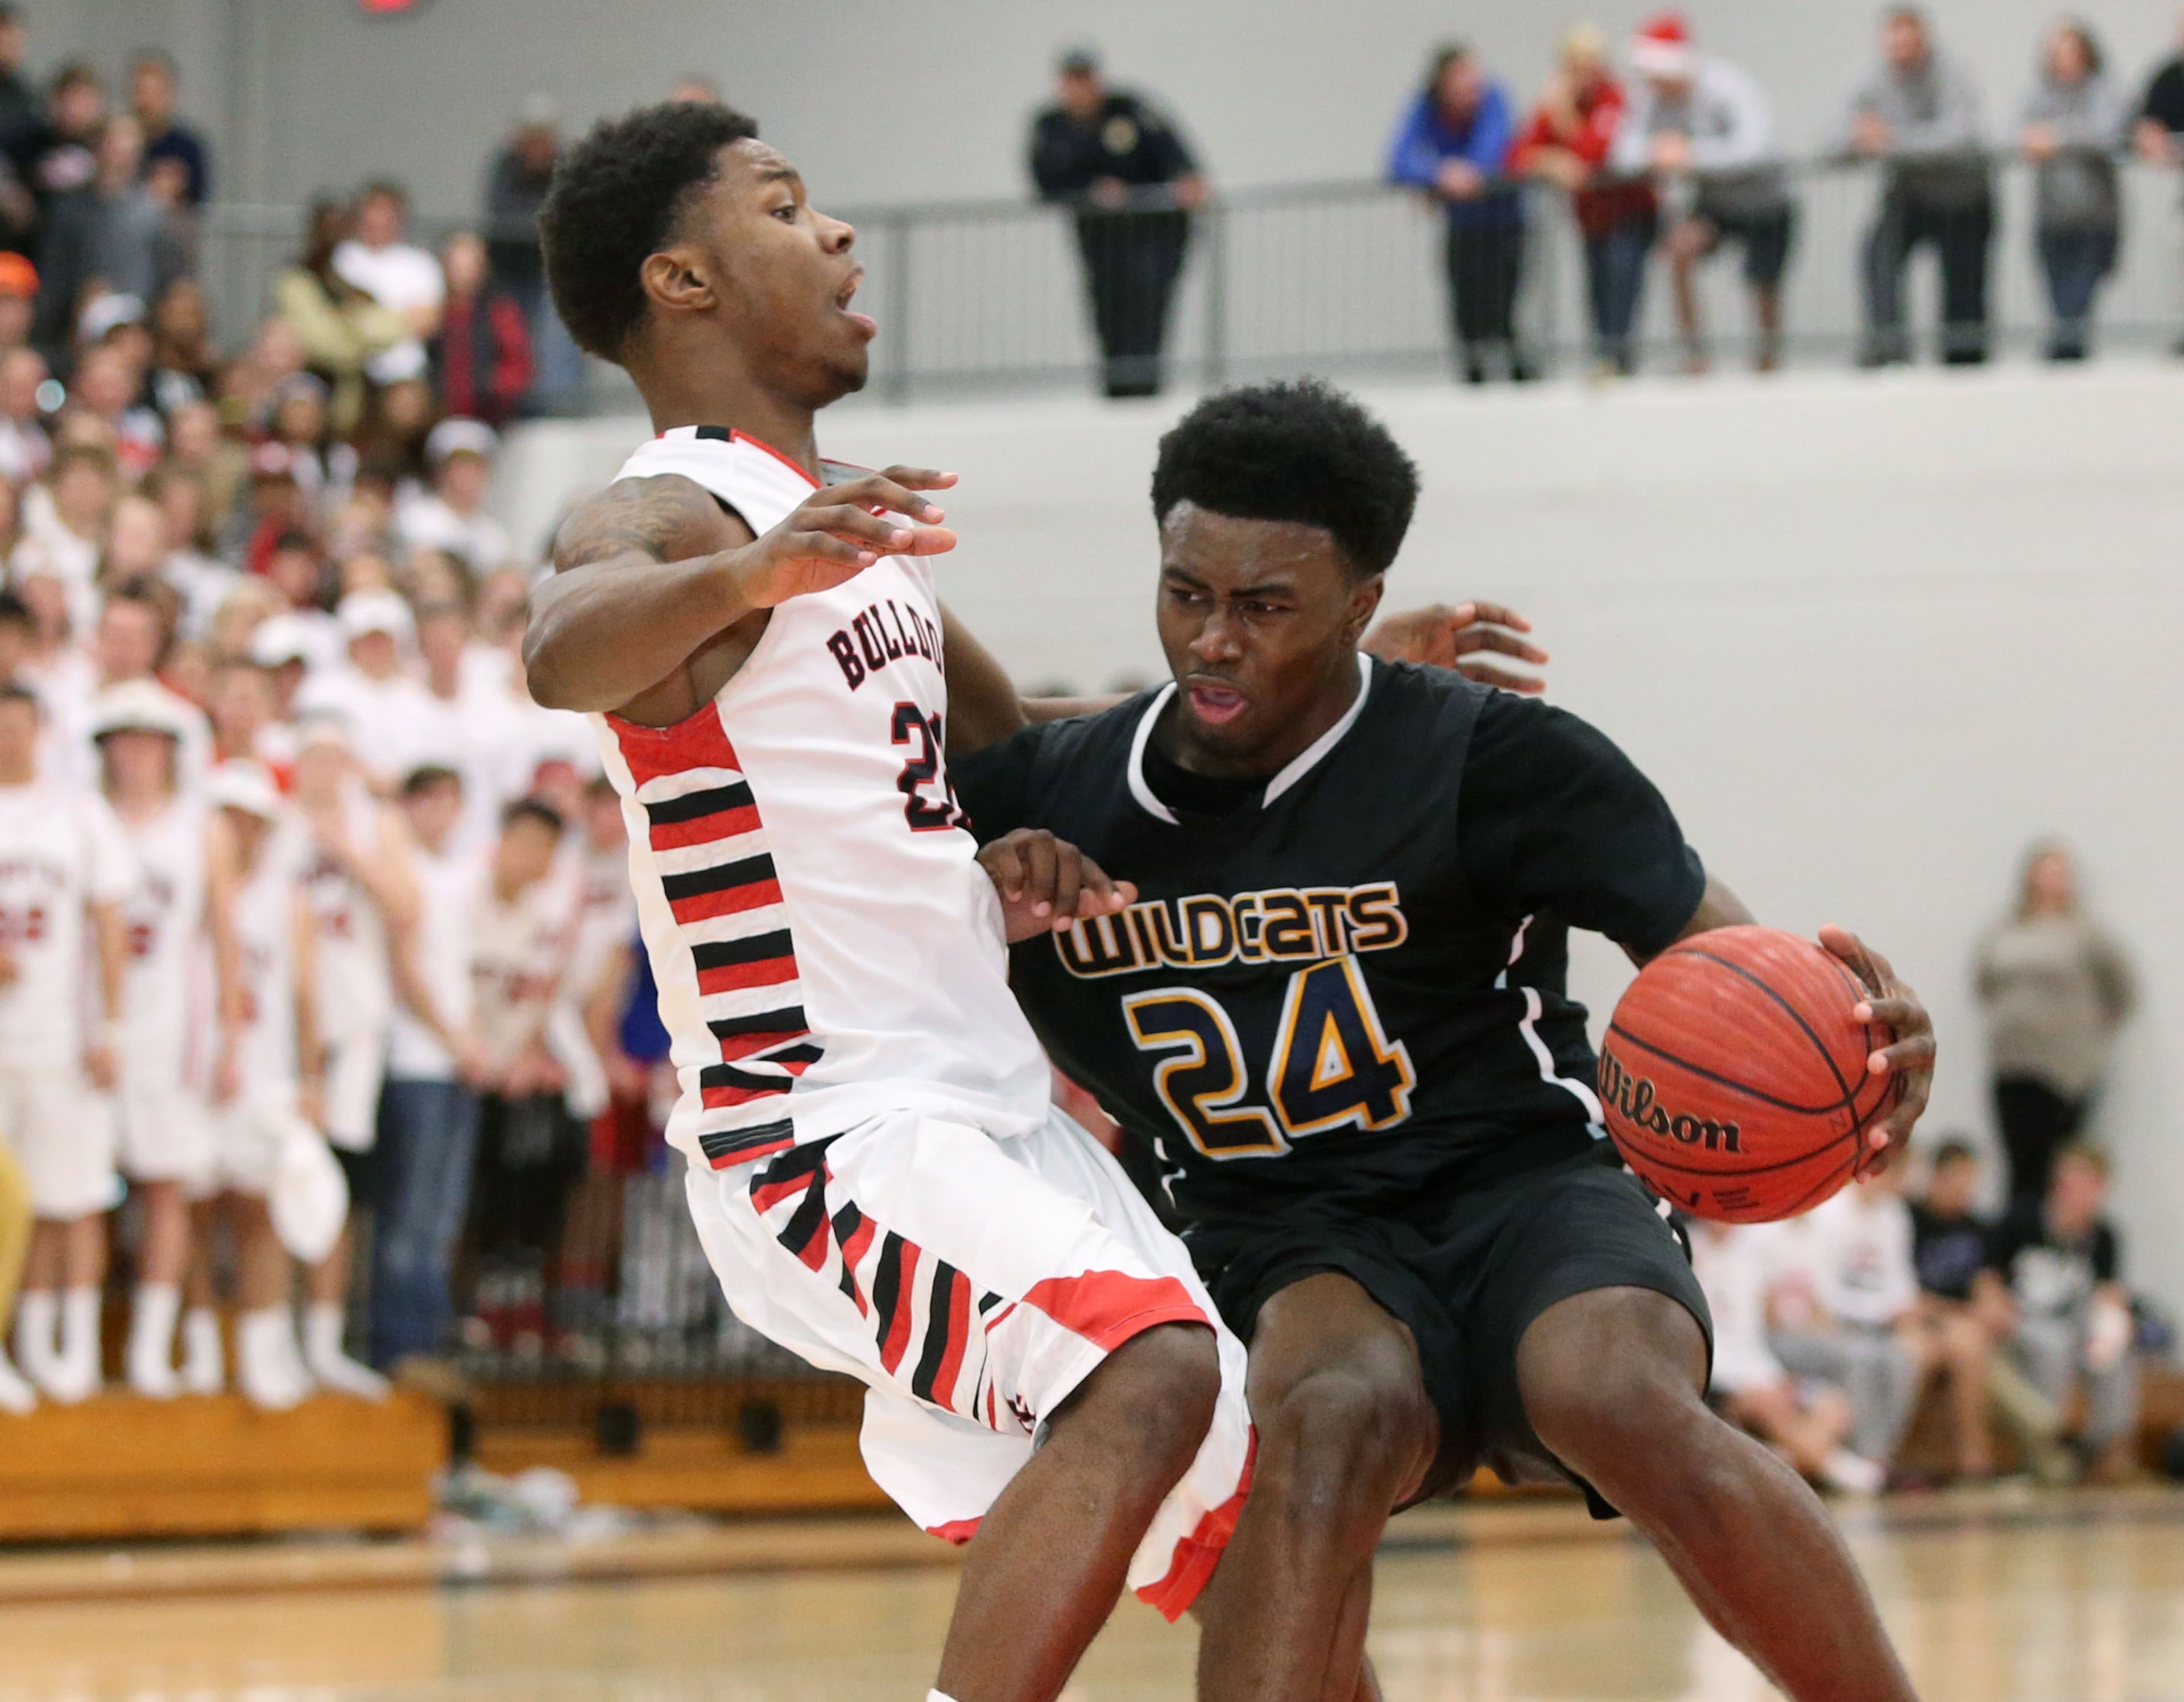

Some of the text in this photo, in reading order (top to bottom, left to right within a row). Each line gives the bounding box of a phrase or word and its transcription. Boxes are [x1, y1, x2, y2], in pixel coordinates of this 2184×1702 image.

[826, 599, 945, 692] BULLDO
[1121, 953, 1417, 1161] 24
[1597, 1044, 1742, 1153] Wilson
